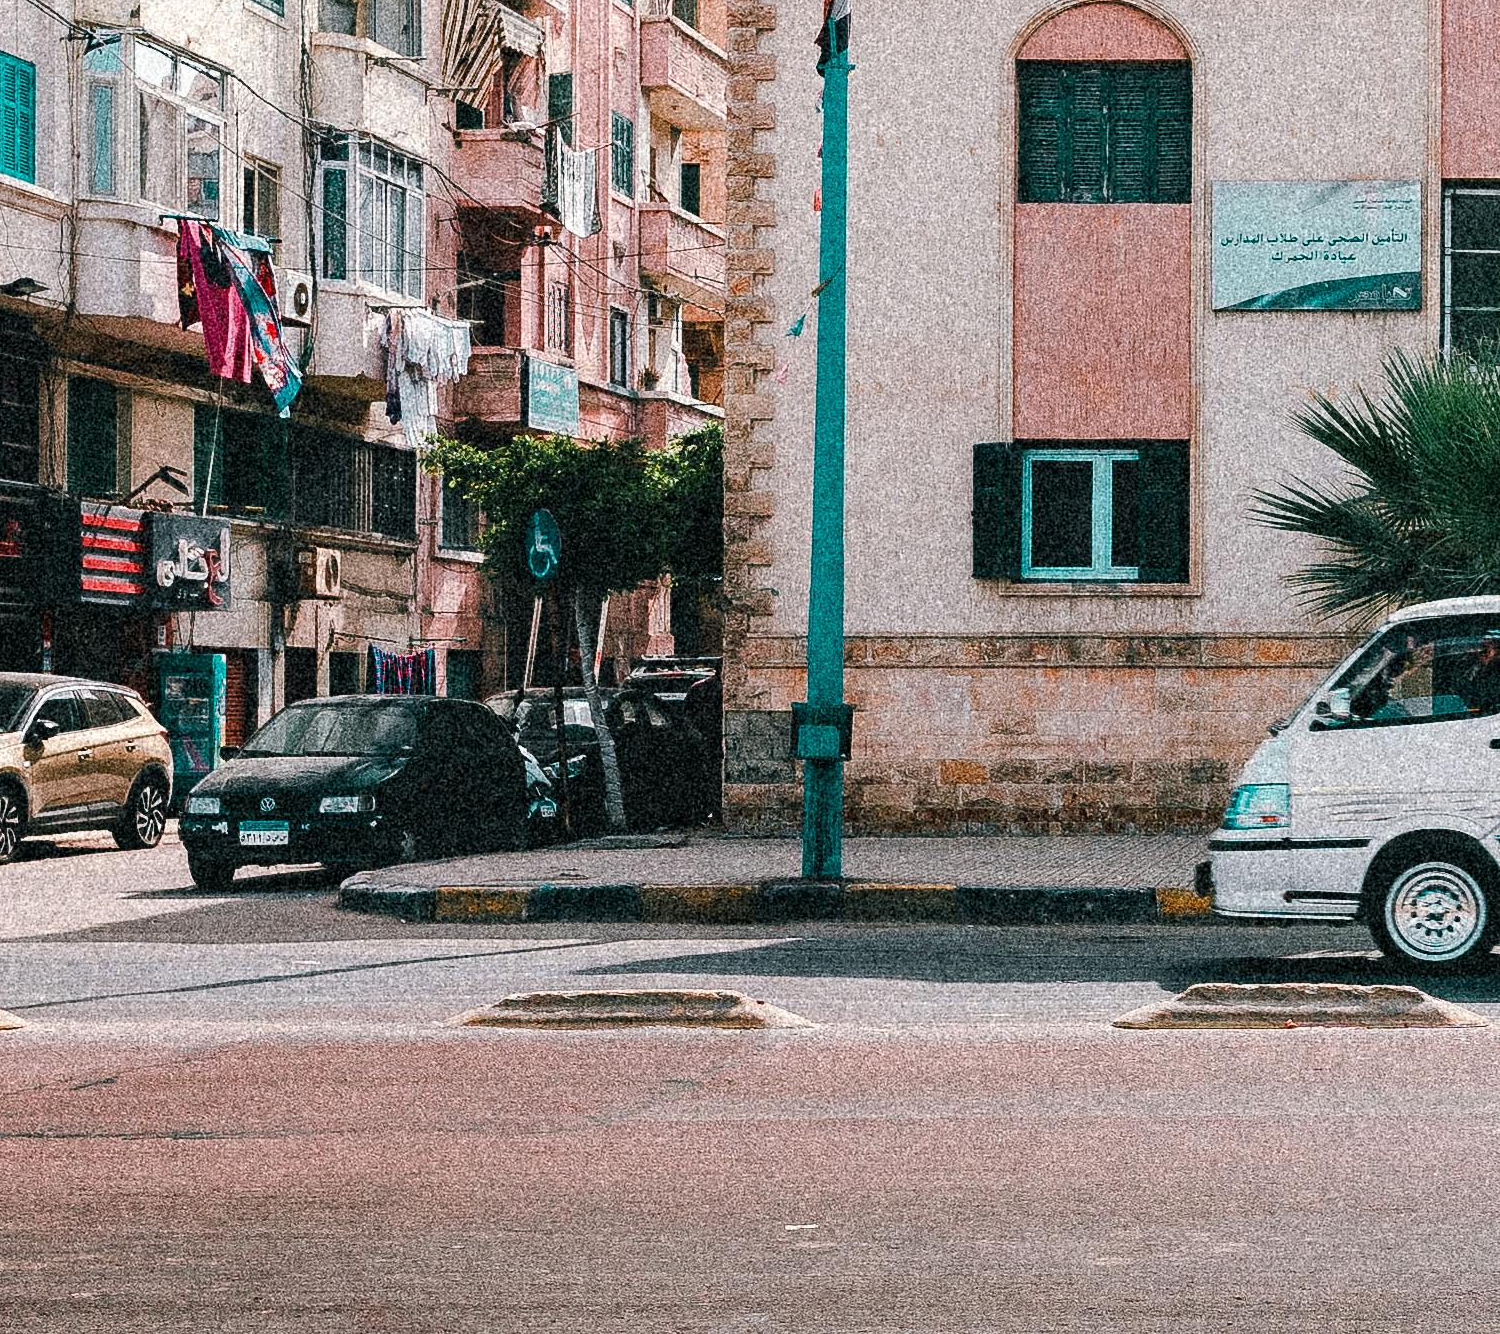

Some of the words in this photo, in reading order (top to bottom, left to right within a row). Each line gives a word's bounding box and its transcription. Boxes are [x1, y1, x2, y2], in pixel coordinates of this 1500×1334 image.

[1220, 231, 1264, 247] المدارس
[1266, 231, 1299, 246] طلاب
[1371, 228, 1408, 246] التأمين
[1323, 250, 1357, 265] عيادة
